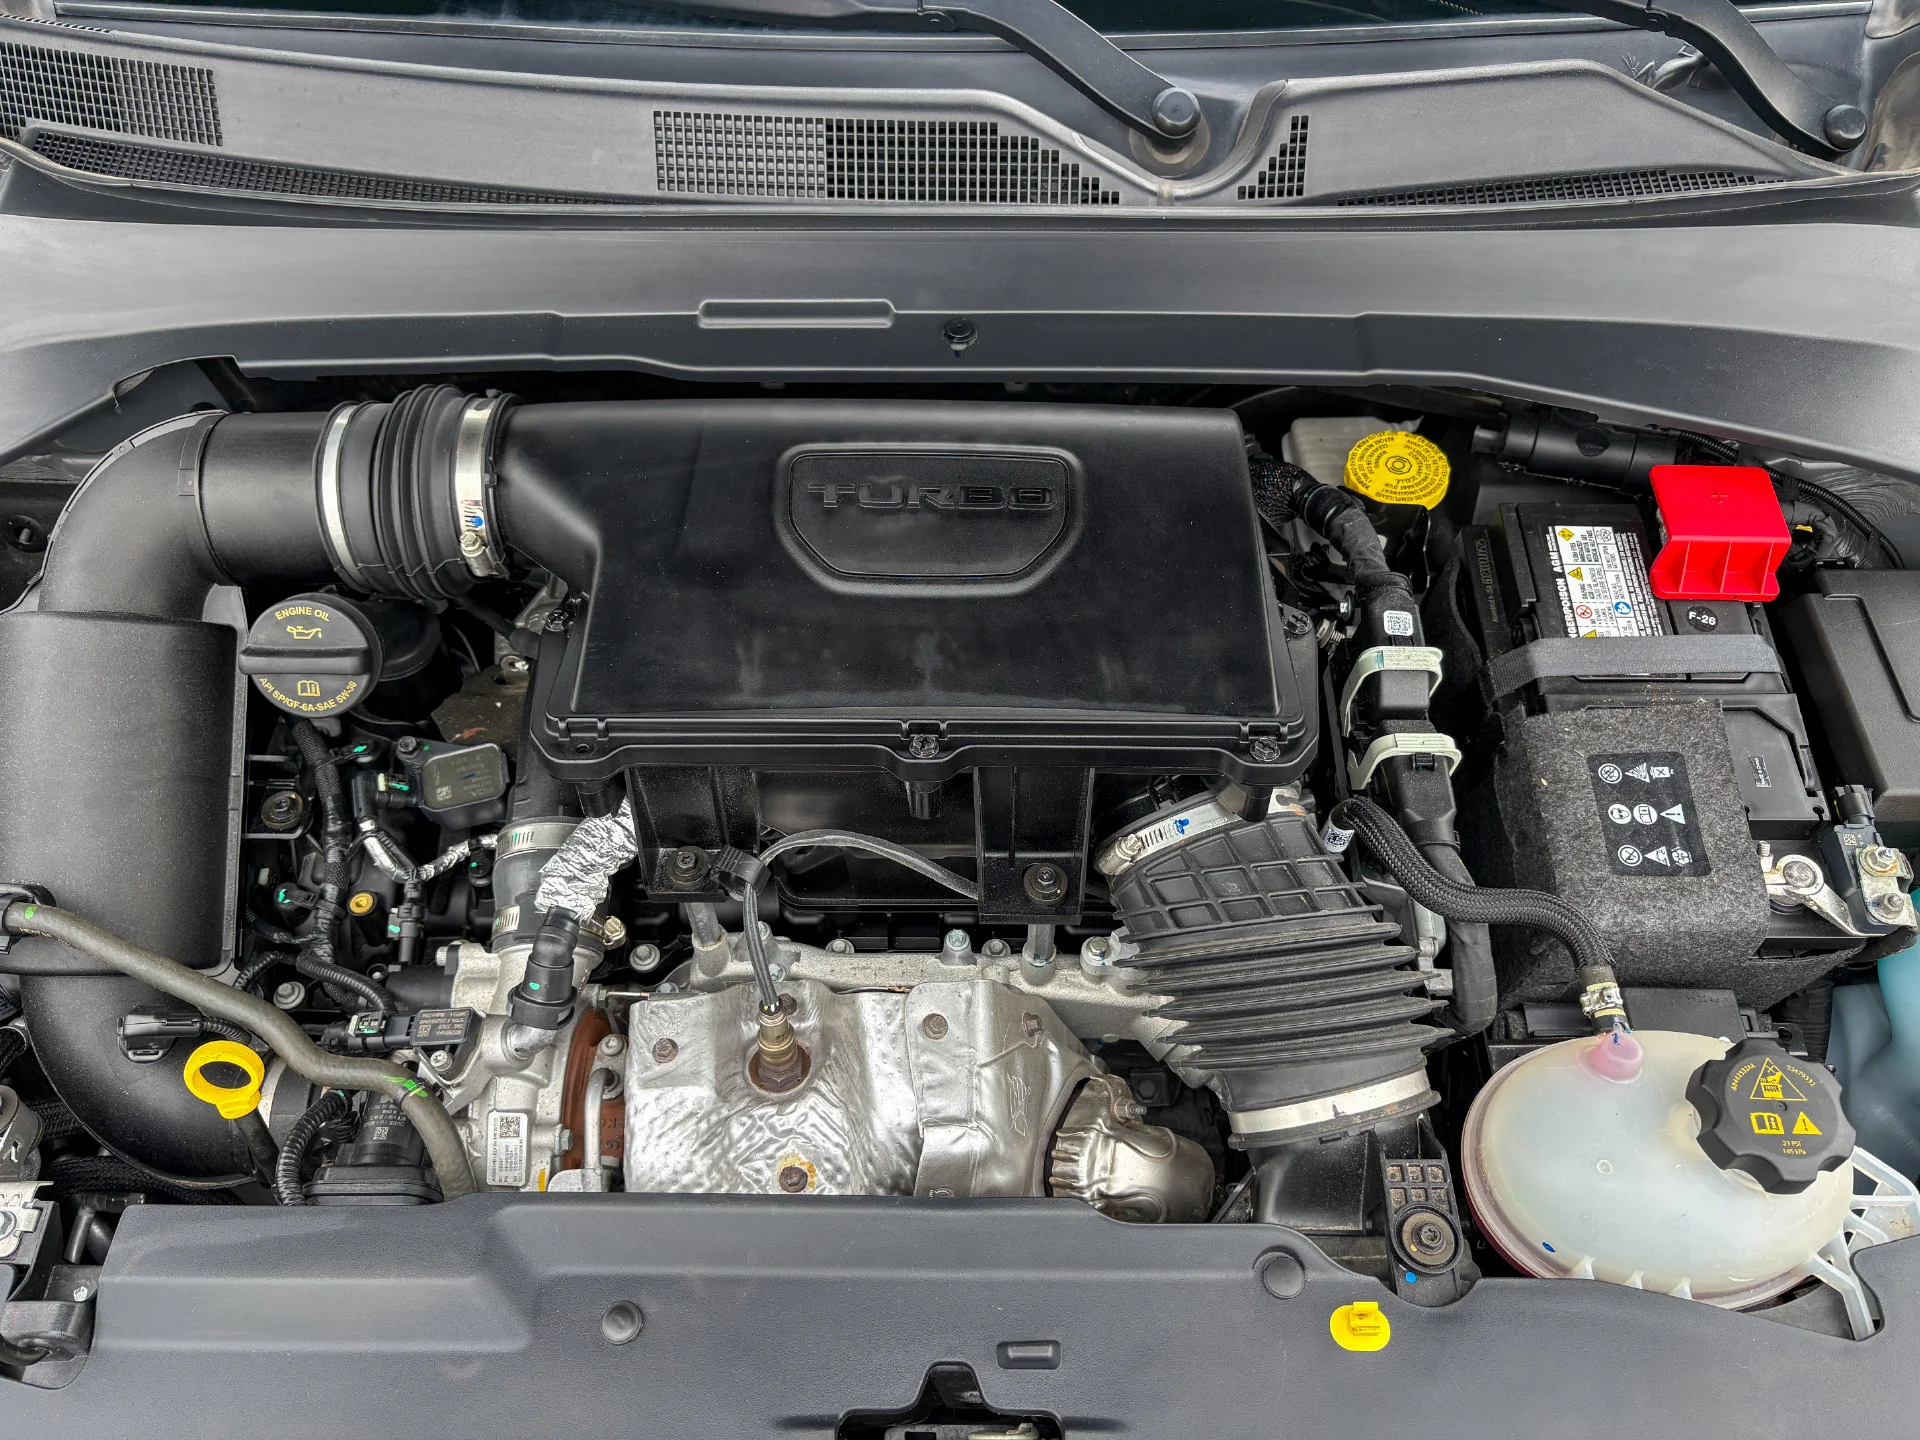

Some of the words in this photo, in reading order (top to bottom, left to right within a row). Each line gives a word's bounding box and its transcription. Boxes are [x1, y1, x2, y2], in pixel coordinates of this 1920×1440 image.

[806, 483, 1054, 510] TURBO
[1549, 551, 1562, 572] AGM
[275, 606, 313, 620] ENGINE
[314, 609, 330, 622] OIL
[1688, 611, 1717, 626] F-26
[259, 678, 274, 693] API
[336, 681, 357, 704] 5W-30
